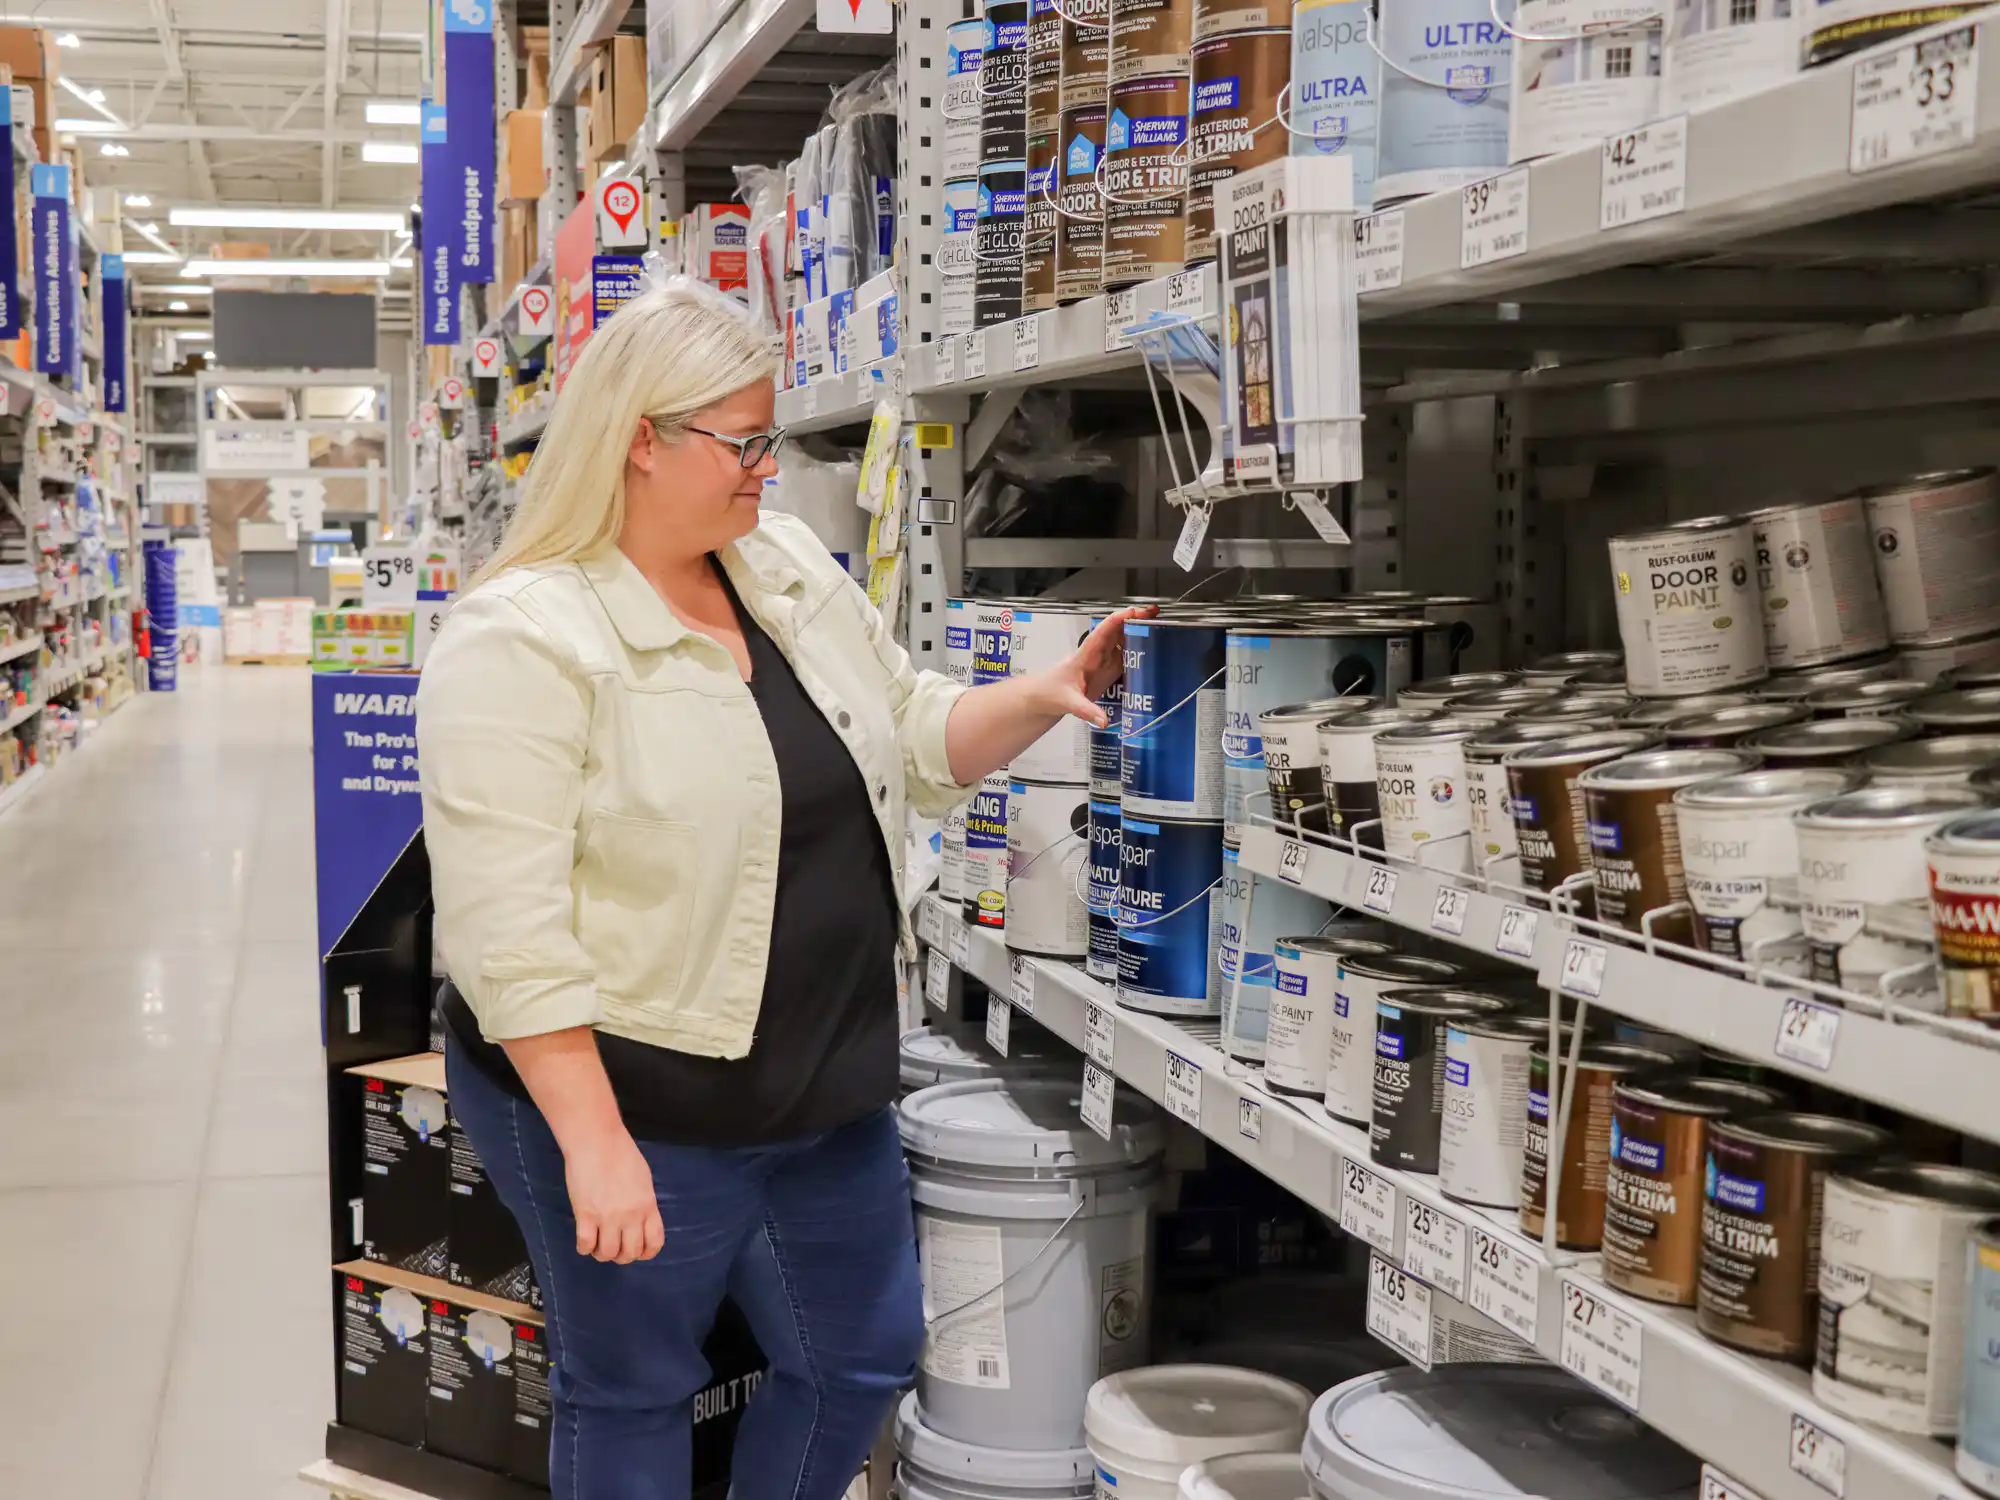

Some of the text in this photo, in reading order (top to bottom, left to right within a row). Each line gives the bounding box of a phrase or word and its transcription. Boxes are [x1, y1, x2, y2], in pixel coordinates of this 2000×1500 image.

[1068, 0, 1107, 17] DOOR
[1425, 21, 1513, 48] ULTRA
[1127, 60, 1143, 69] WHITE
[1197, 82, 1232, 98] SHERWIN
[1301, 76, 1368, 103] ULTRA
[1196, 95, 1232, 111] WILLIAMS
[1134, 121, 1179, 132] SHERWIN
[1200, 117, 1249, 134] EXTERIOR
[1133, 132, 1178, 144] WILLIAMS
[1205, 131, 1254, 153] TRIM
[1605, 134, 1637, 168] $42
[1131, 157, 1137, 167] &
[1132, 170, 1144, 188] &
[1208, 169, 1233, 179] FINISH
[1063, 183, 1096, 195] INTERIOR
[613, 195, 630, 207] 12
[1061, 194, 1097, 213] DOOR
[1150, 200, 1179, 209] FINISH
[1464, 183, 1489, 215] $39
[462, 166, 483, 267] Sandpaper
[1234, 201, 1265, 230] DOOR
[1234, 224, 1267, 257] PAINT
[1115, 264, 1152, 275] ULTRA WHITE
[433, 245, 452, 333] Drop Cloths
[1080, 283, 1099, 293] ULTRA
[1648, 551, 1716, 568] RUST-OLEUM
[1651, 566, 1718, 590] DOOR
[1654, 585, 1720, 610] PAINT
[977, 614, 1002, 624] ZINSSER
[980, 657, 1007, 673] Primer
[344, 731, 417, 749] The Pro's
[372, 754, 396, 770] for
[342, 776, 371, 792] and
[974, 820, 1008, 835] & Prime
[1522, 842, 1556, 858] TRIM
[1600, 872, 1642, 891] TRIM
[1715, 882, 1762, 894] & TRIM
[990, 897, 1003, 905] COAT
[1825, 906, 1859, 920] TRIM
[1279, 973, 1303, 985] SHERWIN
[1278, 983, 1303, 994] WILLIAMS
[1281, 1005, 1314, 1022] PAINT
[1377, 1032, 1400, 1046] SHERWIN
[1379, 1056, 1410, 1071] EXTERIOR
[365, 1076, 384, 1093] 3M
[365, 1099, 377, 1111] COOL
[1623, 1137, 1659, 1157] SHERWIN
[1621, 1148, 1658, 1169] WILLIAMS
[1345, 1161, 1365, 1194] $25
[1625, 1170, 1672, 1194] EXTERIOR
[1719, 1174, 1758, 1196] SHERWIN
[1630, 1187, 1677, 1214] TRIM
[1718, 1189, 1757, 1210] WILLIAMS
[1408, 1201, 1431, 1235] $25
[1720, 1211, 1774, 1236] EXTERIOR
[1475, 1231, 1499, 1269] $26
[1725, 1228, 1779, 1259] TRIM
[346, 1277, 364, 1293] 3M
[1374, 1260, 1406, 1302] $165
[431, 1300, 449, 1316] 3M
[1567, 1285, 1596, 1325] $27
[516, 1325, 535, 1341] 3M
[693, 1379, 739, 1424] BUILT
